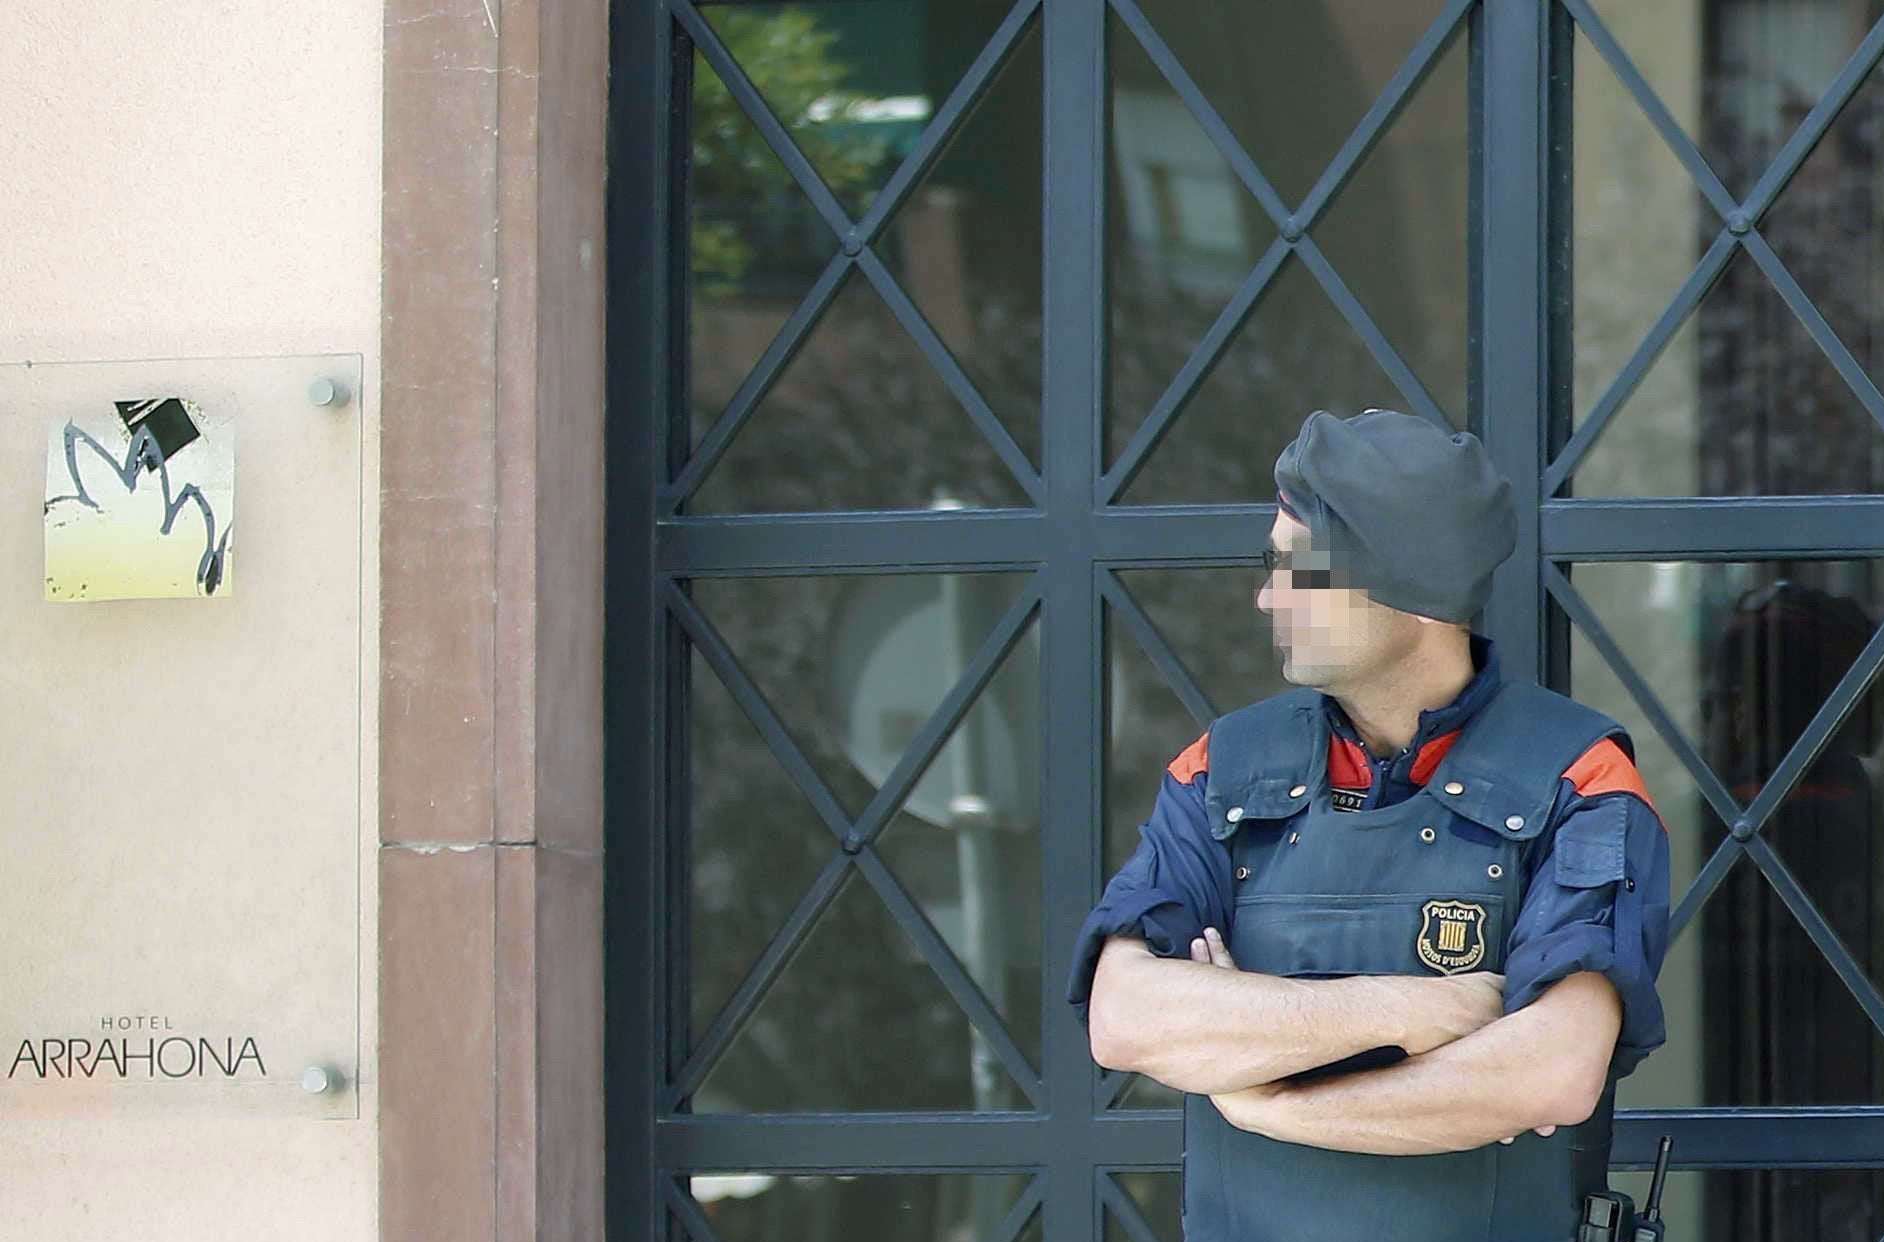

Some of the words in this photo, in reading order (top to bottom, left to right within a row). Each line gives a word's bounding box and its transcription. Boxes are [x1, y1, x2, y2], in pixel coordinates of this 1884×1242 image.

[1431, 906, 1475, 921] POLICIA
[101, 1016, 173, 1030] HOTEL
[8, 1037, 267, 1078] ARRAHONA
